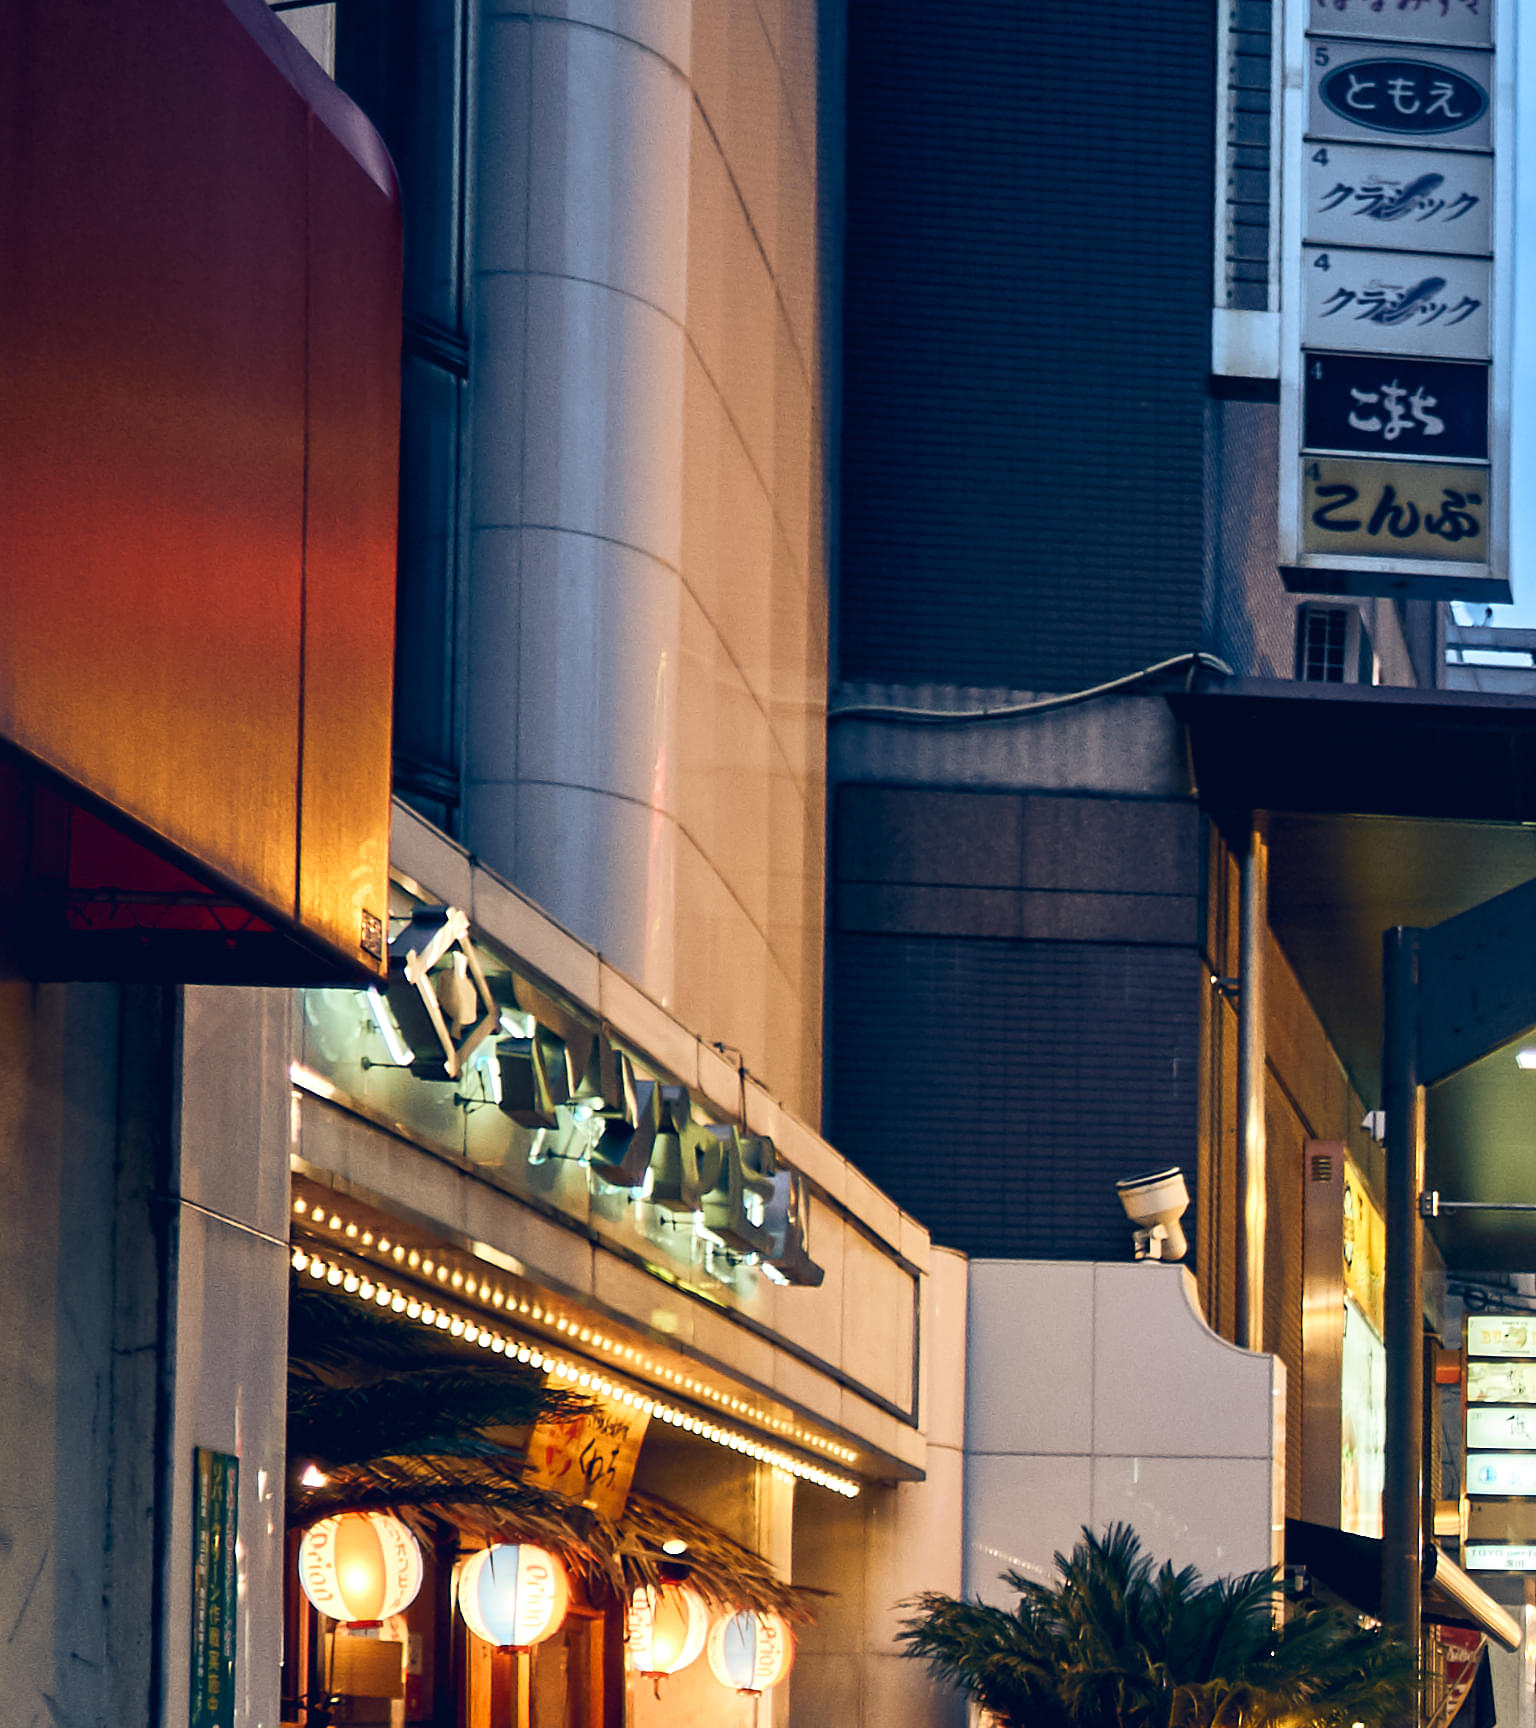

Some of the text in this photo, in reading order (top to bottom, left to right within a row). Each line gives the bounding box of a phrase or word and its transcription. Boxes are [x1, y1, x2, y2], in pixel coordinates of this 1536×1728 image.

[1315, 48, 1330, 66] 5
[1346, 73, 1463, 118] ともえ
[1312, 149, 1329, 167] 4
[1318, 181, 1480, 222] クラシック
[1313, 254, 1331, 272] 4
[1321, 286, 1482, 328] クラシック
[1348, 380, 1445, 441] こまち
[1312, 485, 1482, 542] こんぶ
[308, 1531, 334, 1602] Orion
[522, 1564, 556, 1628] Orion
